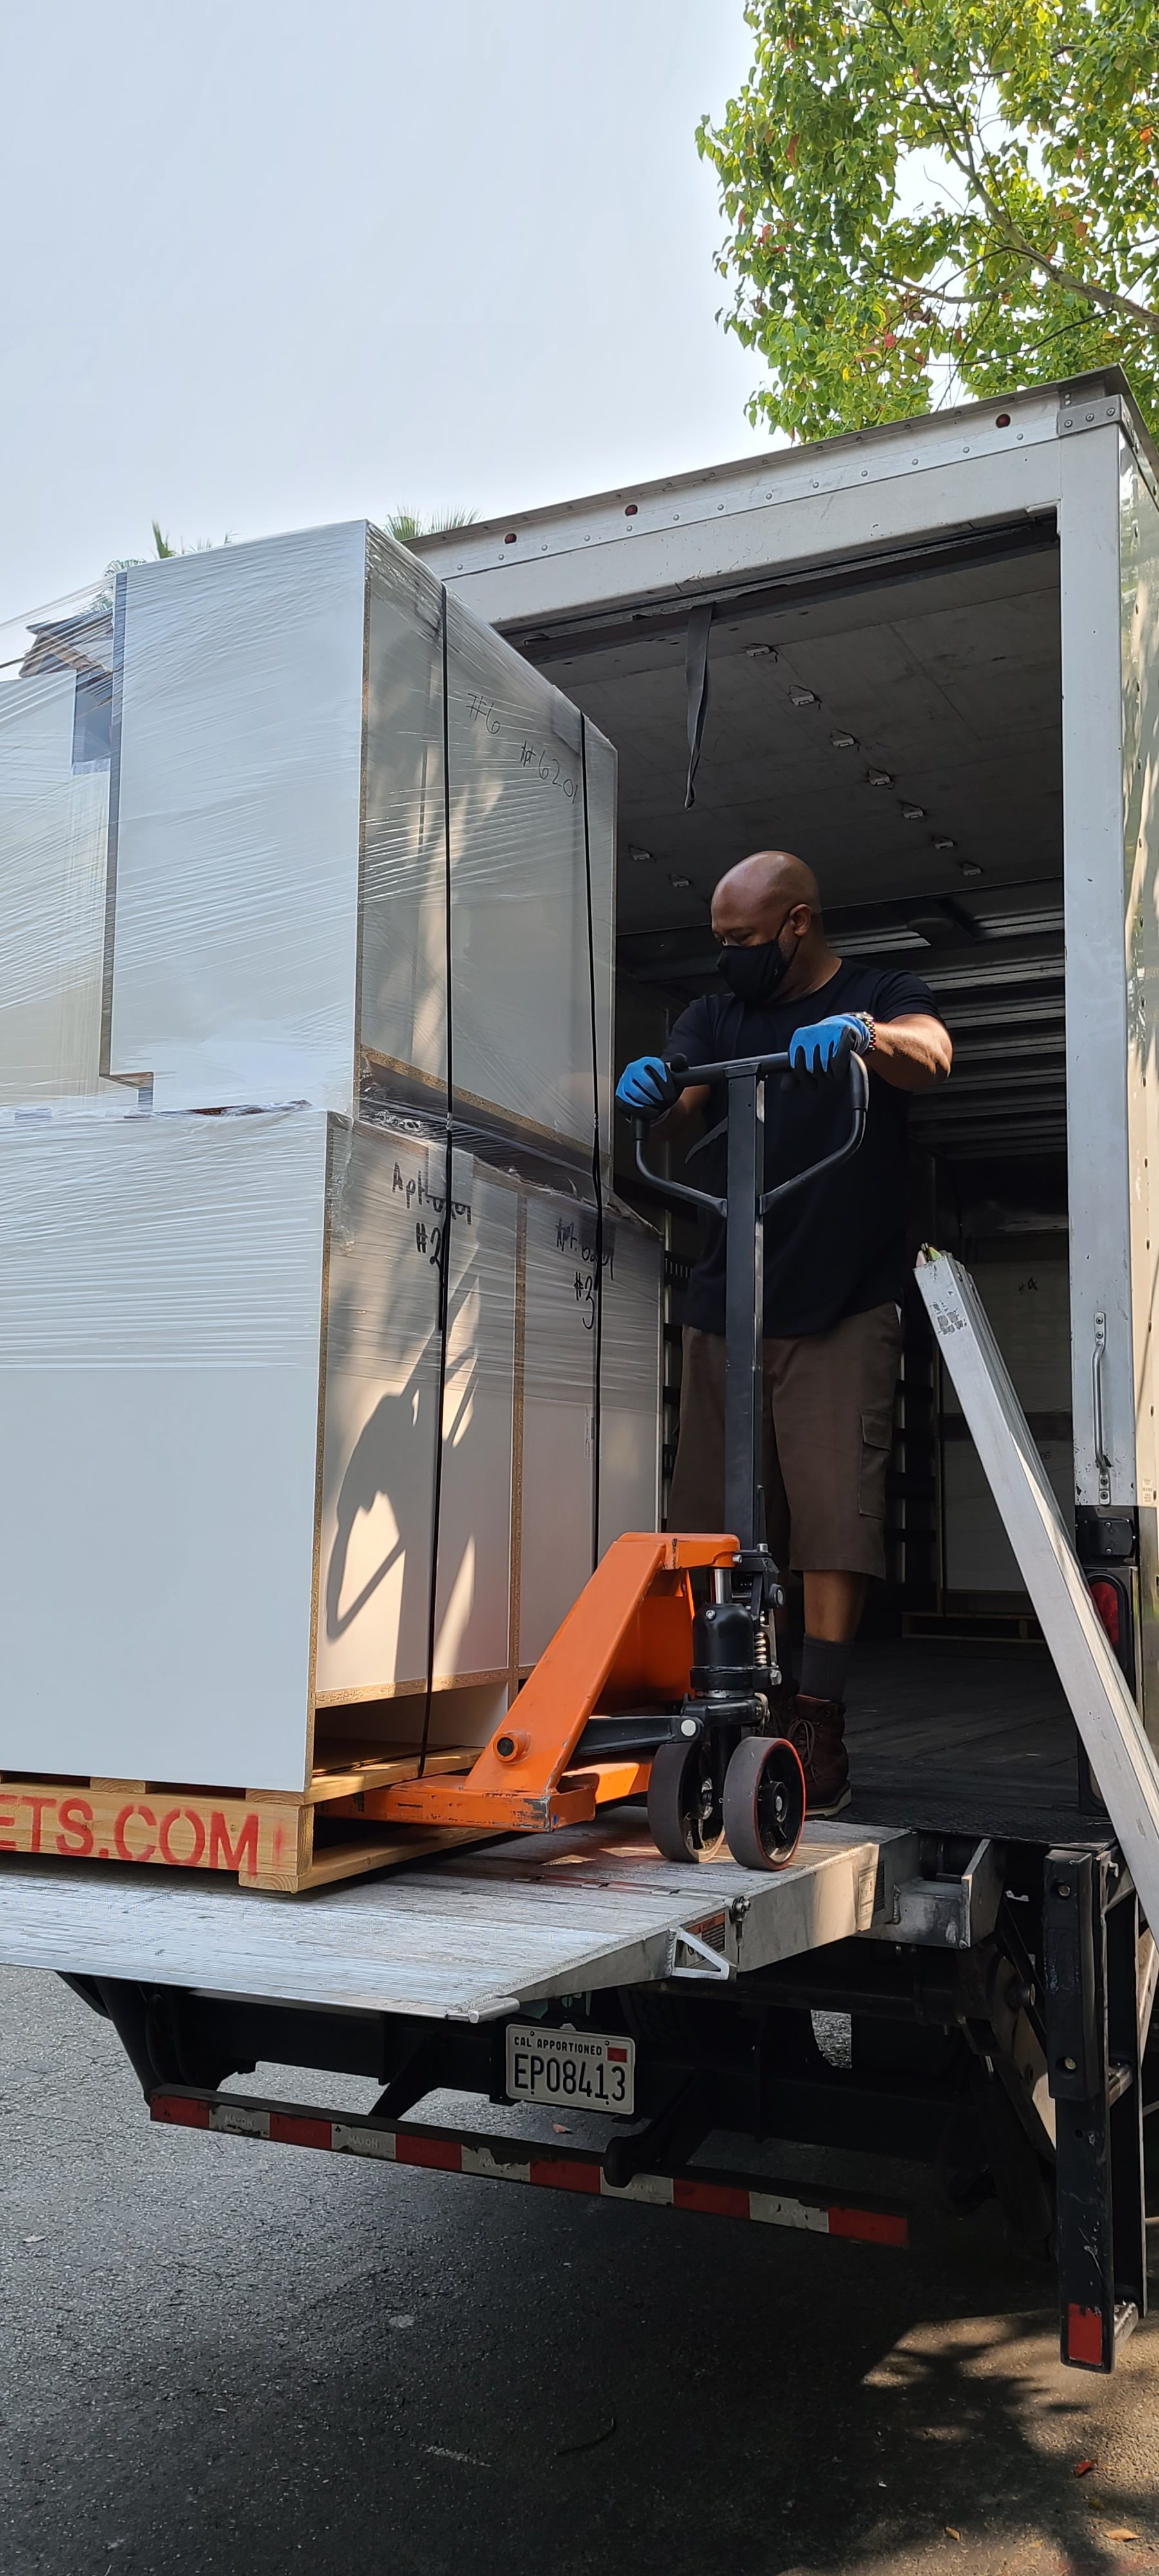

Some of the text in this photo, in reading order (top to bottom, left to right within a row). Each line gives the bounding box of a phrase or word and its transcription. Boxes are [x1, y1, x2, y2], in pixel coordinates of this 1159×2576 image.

[574, 1271, 595, 1330] #3
[514, 2036, 602, 2056] CAL APPORTIONED
[514, 2052, 625, 2102] EP08413
